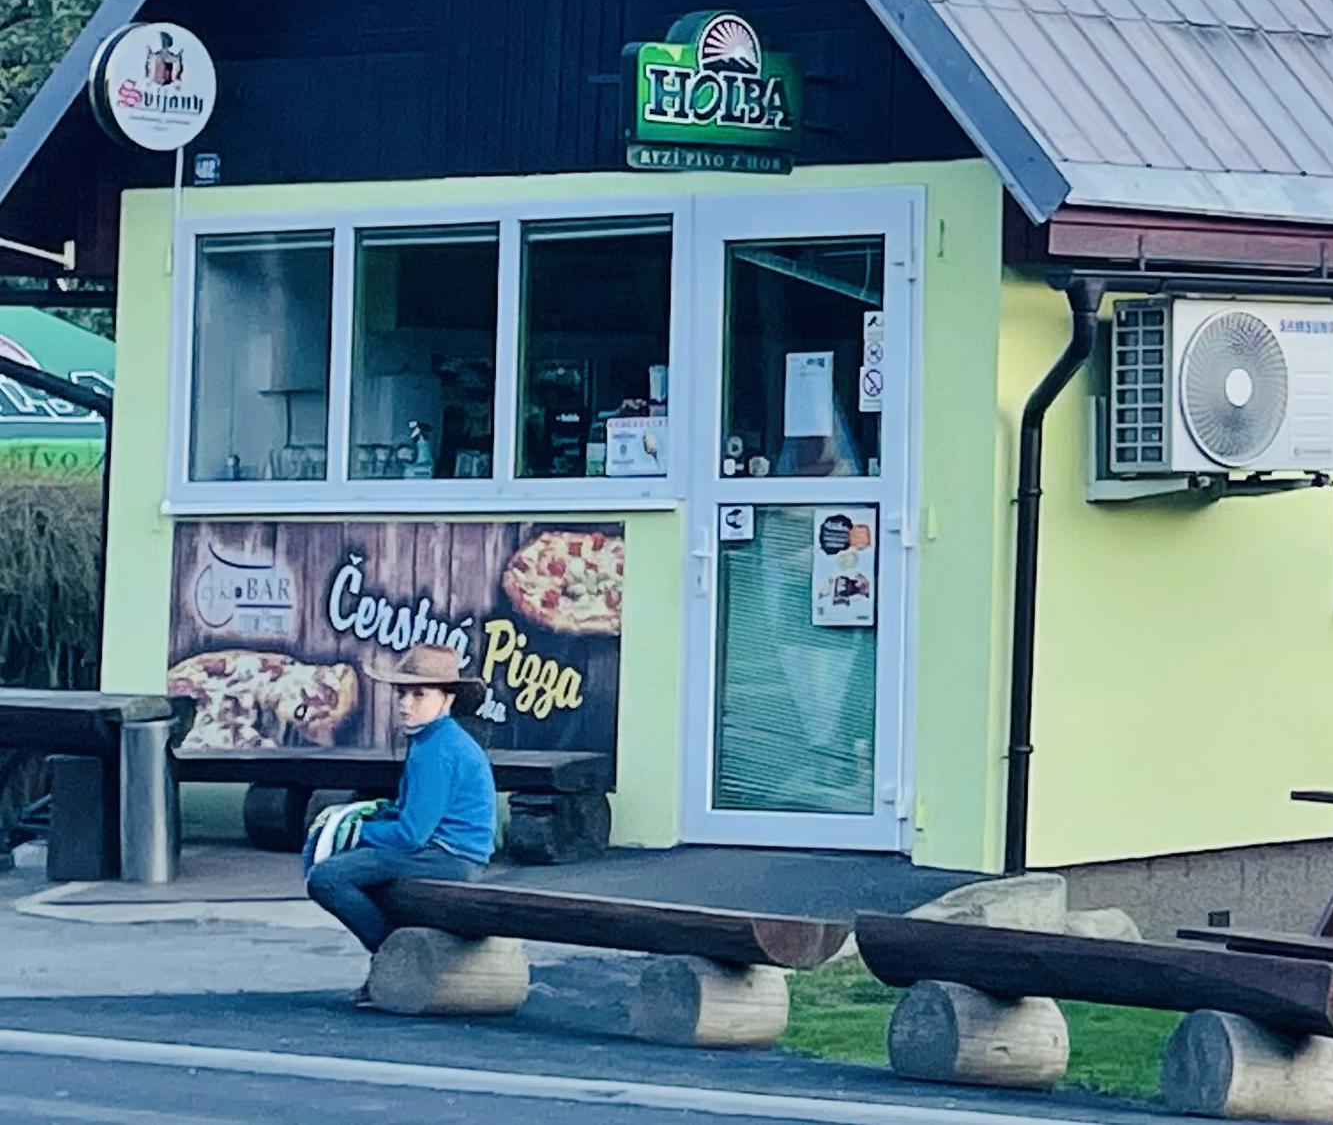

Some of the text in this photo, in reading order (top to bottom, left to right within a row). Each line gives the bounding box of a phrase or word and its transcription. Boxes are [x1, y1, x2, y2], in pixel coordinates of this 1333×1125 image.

[117, 79, 203, 114] Svijany
[645, 65, 792, 131] HOLBA
[330, 554, 474, 669] Čerstvá
[483, 619, 583, 719] Pizza
